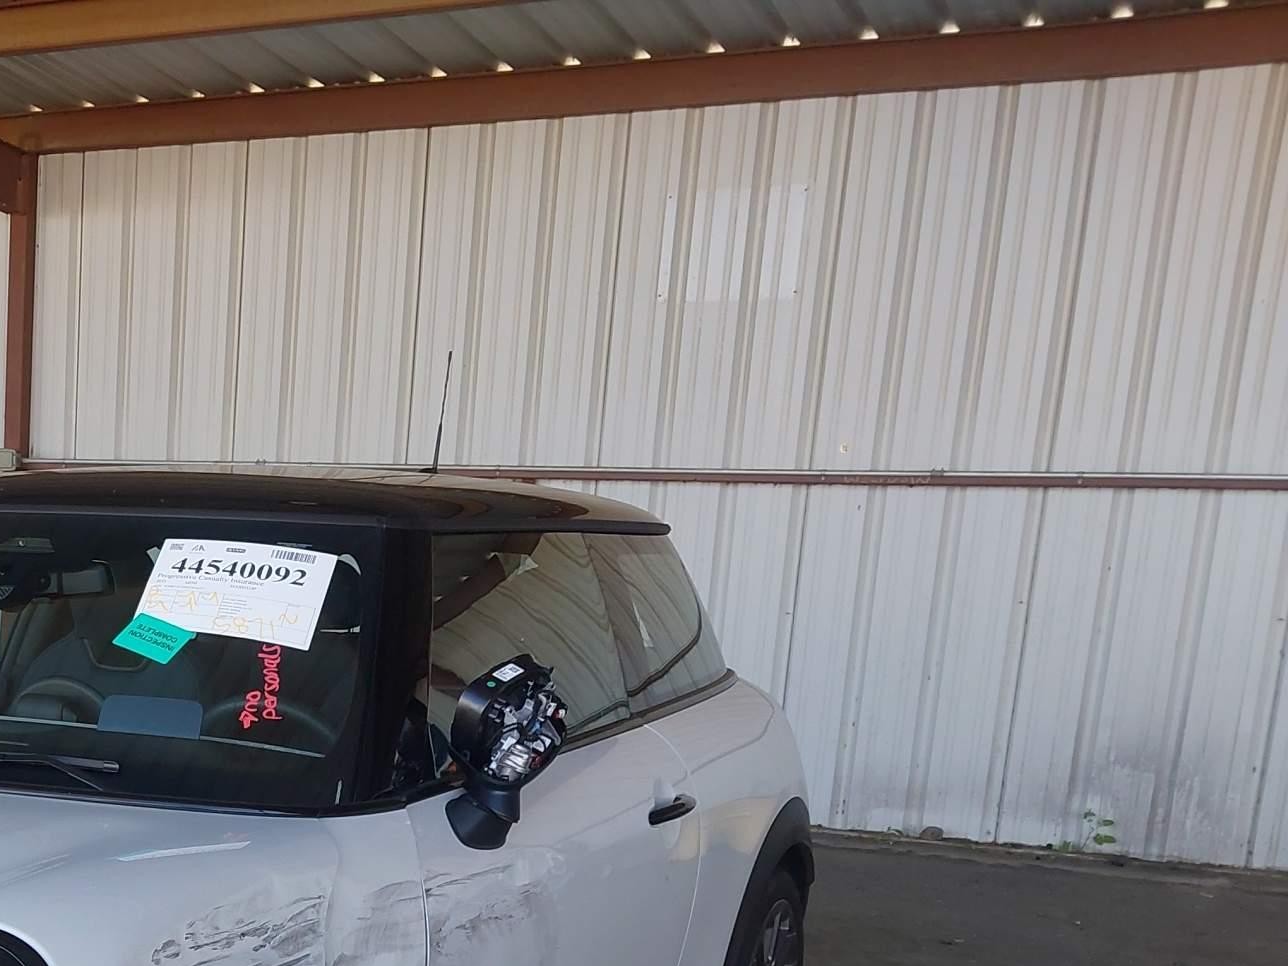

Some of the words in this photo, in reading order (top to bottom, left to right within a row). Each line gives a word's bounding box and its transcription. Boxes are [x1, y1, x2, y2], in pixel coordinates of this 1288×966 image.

[171, 557, 307, 587] 44540092
[128, 629, 175, 652] INSPECTION
[136, 623, 178, 643] COMPLETE
